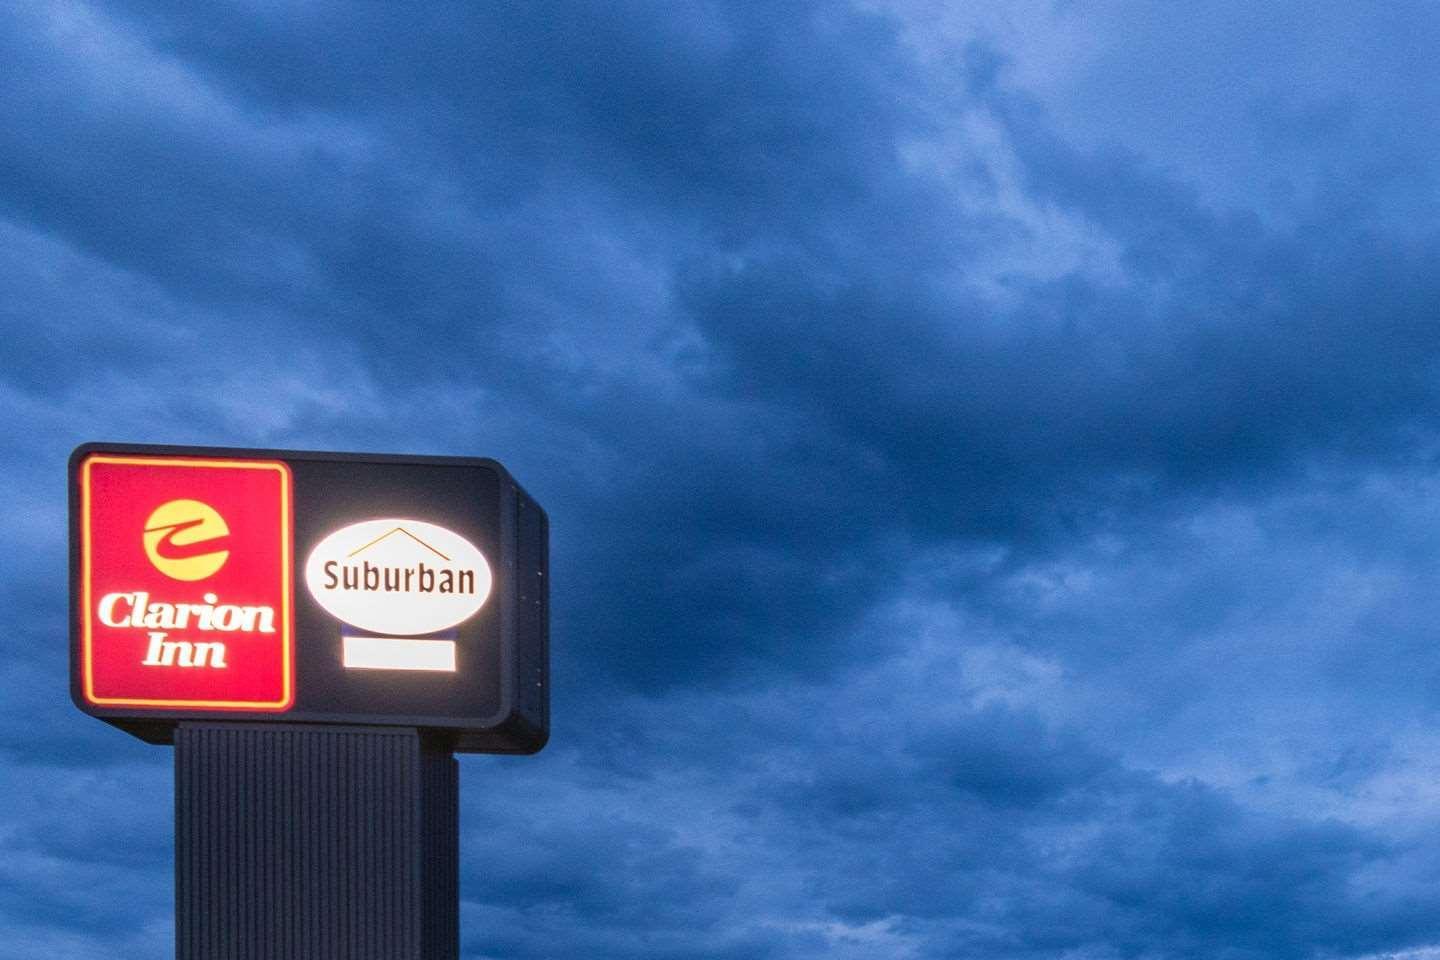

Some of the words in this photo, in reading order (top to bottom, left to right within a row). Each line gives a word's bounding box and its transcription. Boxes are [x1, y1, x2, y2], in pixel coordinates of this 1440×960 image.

[324, 559, 474, 595] Suburban
[97, 591, 276, 634] Clarion
[141, 632, 227, 669] Inn
